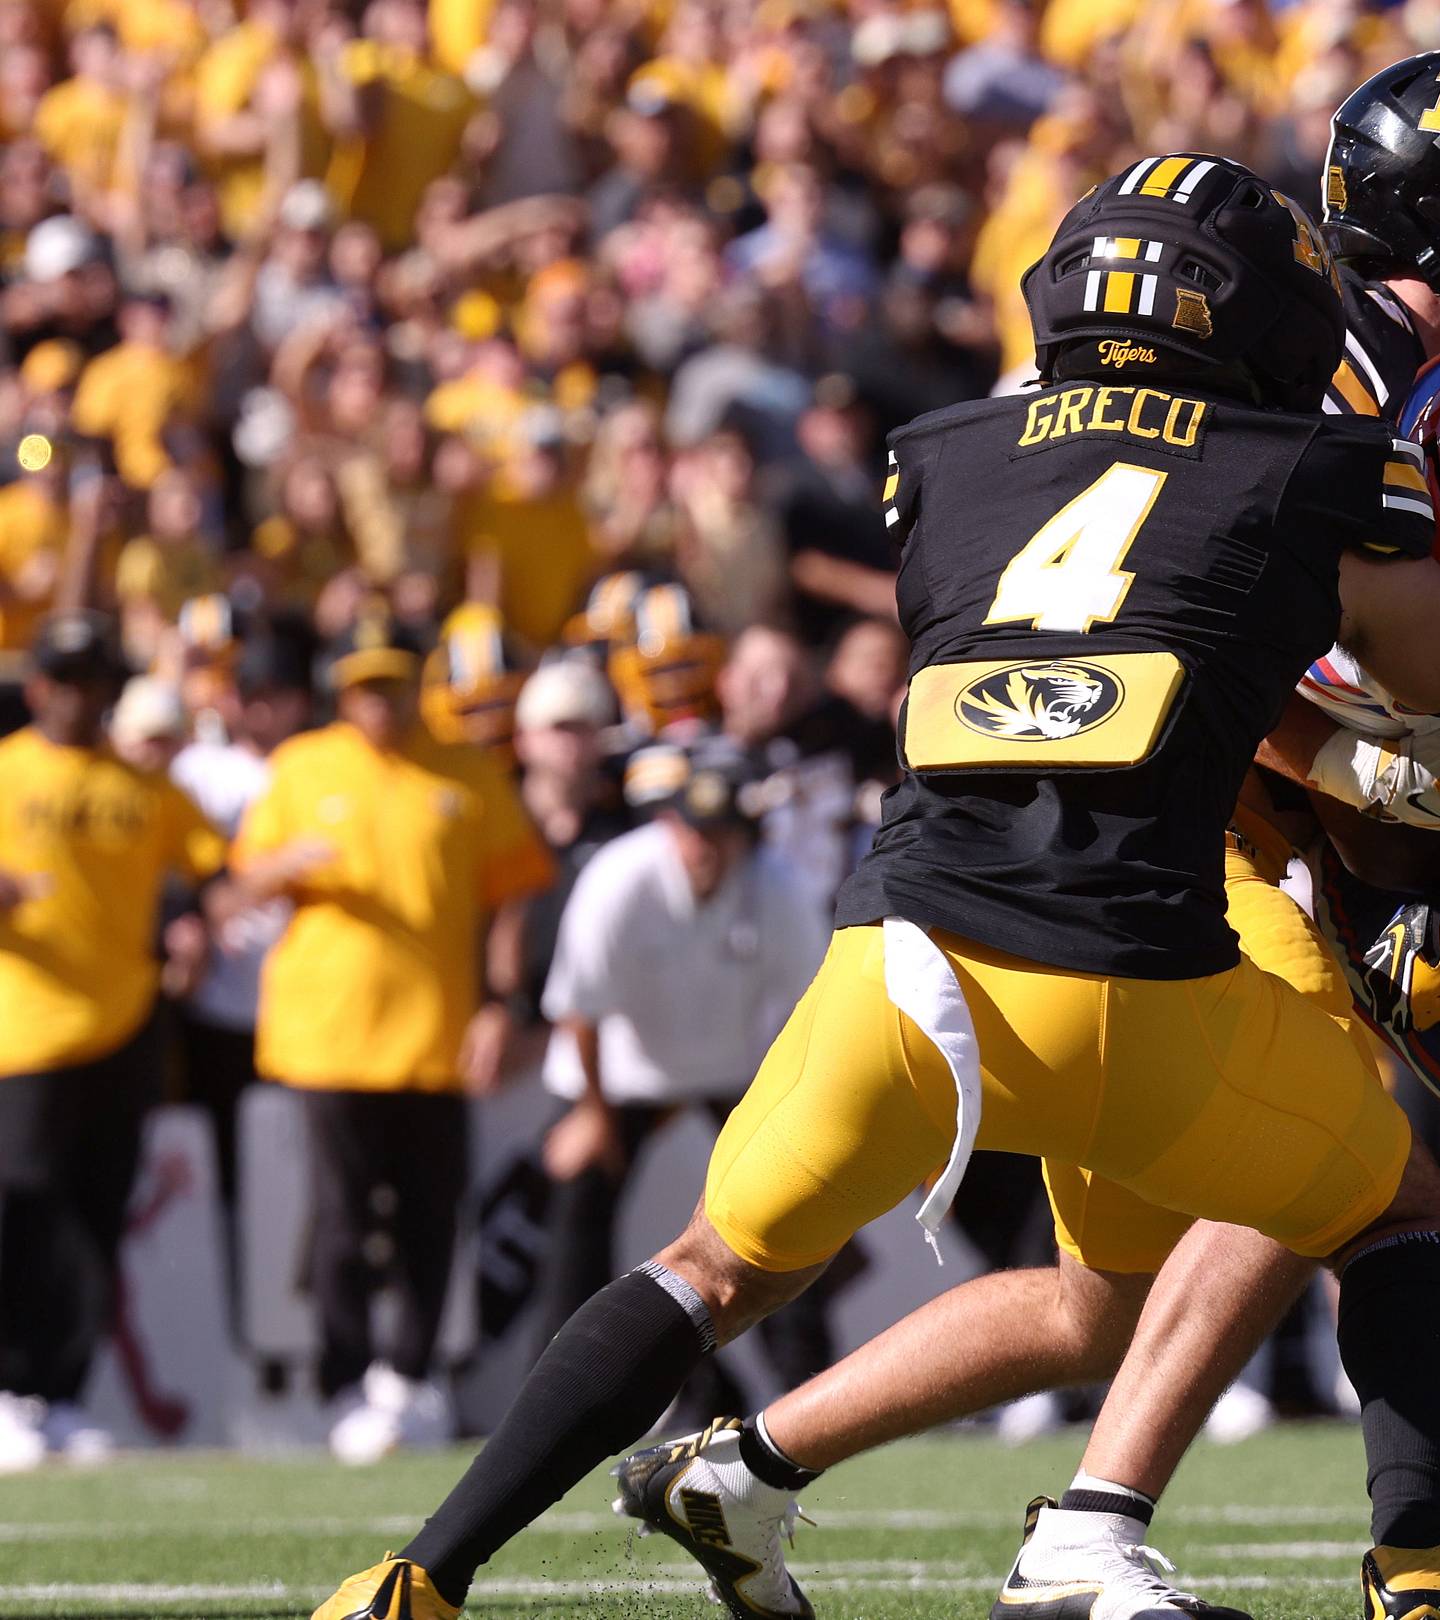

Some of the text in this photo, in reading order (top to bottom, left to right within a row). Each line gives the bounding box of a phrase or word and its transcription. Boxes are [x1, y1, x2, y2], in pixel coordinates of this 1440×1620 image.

[1097, 339, 1158, 369] Tigers
[1017, 386, 1207, 448] GRECO
[981, 460, 1170, 635] 4
